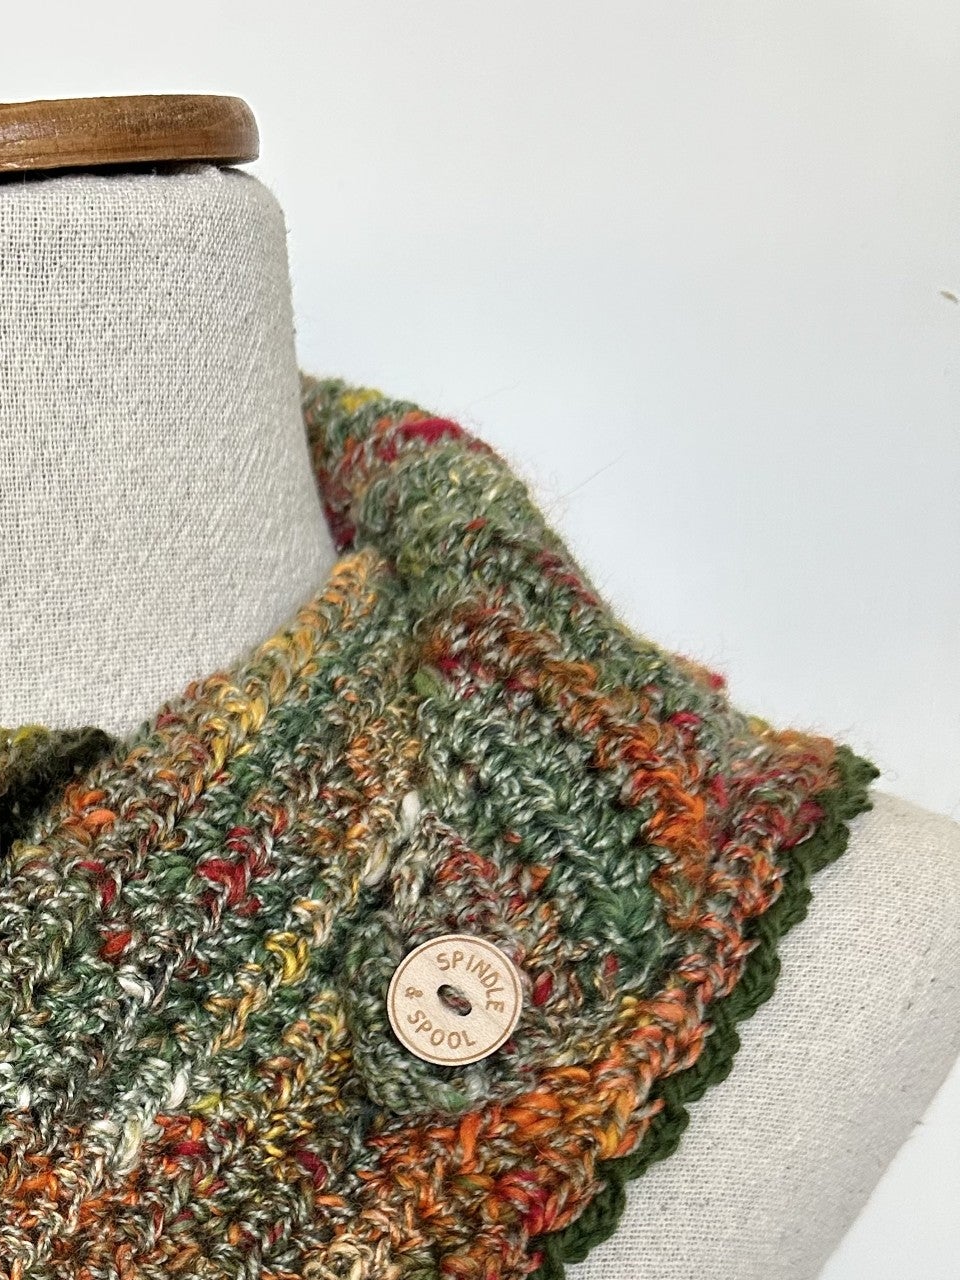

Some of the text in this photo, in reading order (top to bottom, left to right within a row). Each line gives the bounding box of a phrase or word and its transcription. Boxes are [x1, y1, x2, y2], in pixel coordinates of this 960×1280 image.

[436, 950, 505, 1013] SPINDLE
[404, 986, 476, 1050] & SPOOL
